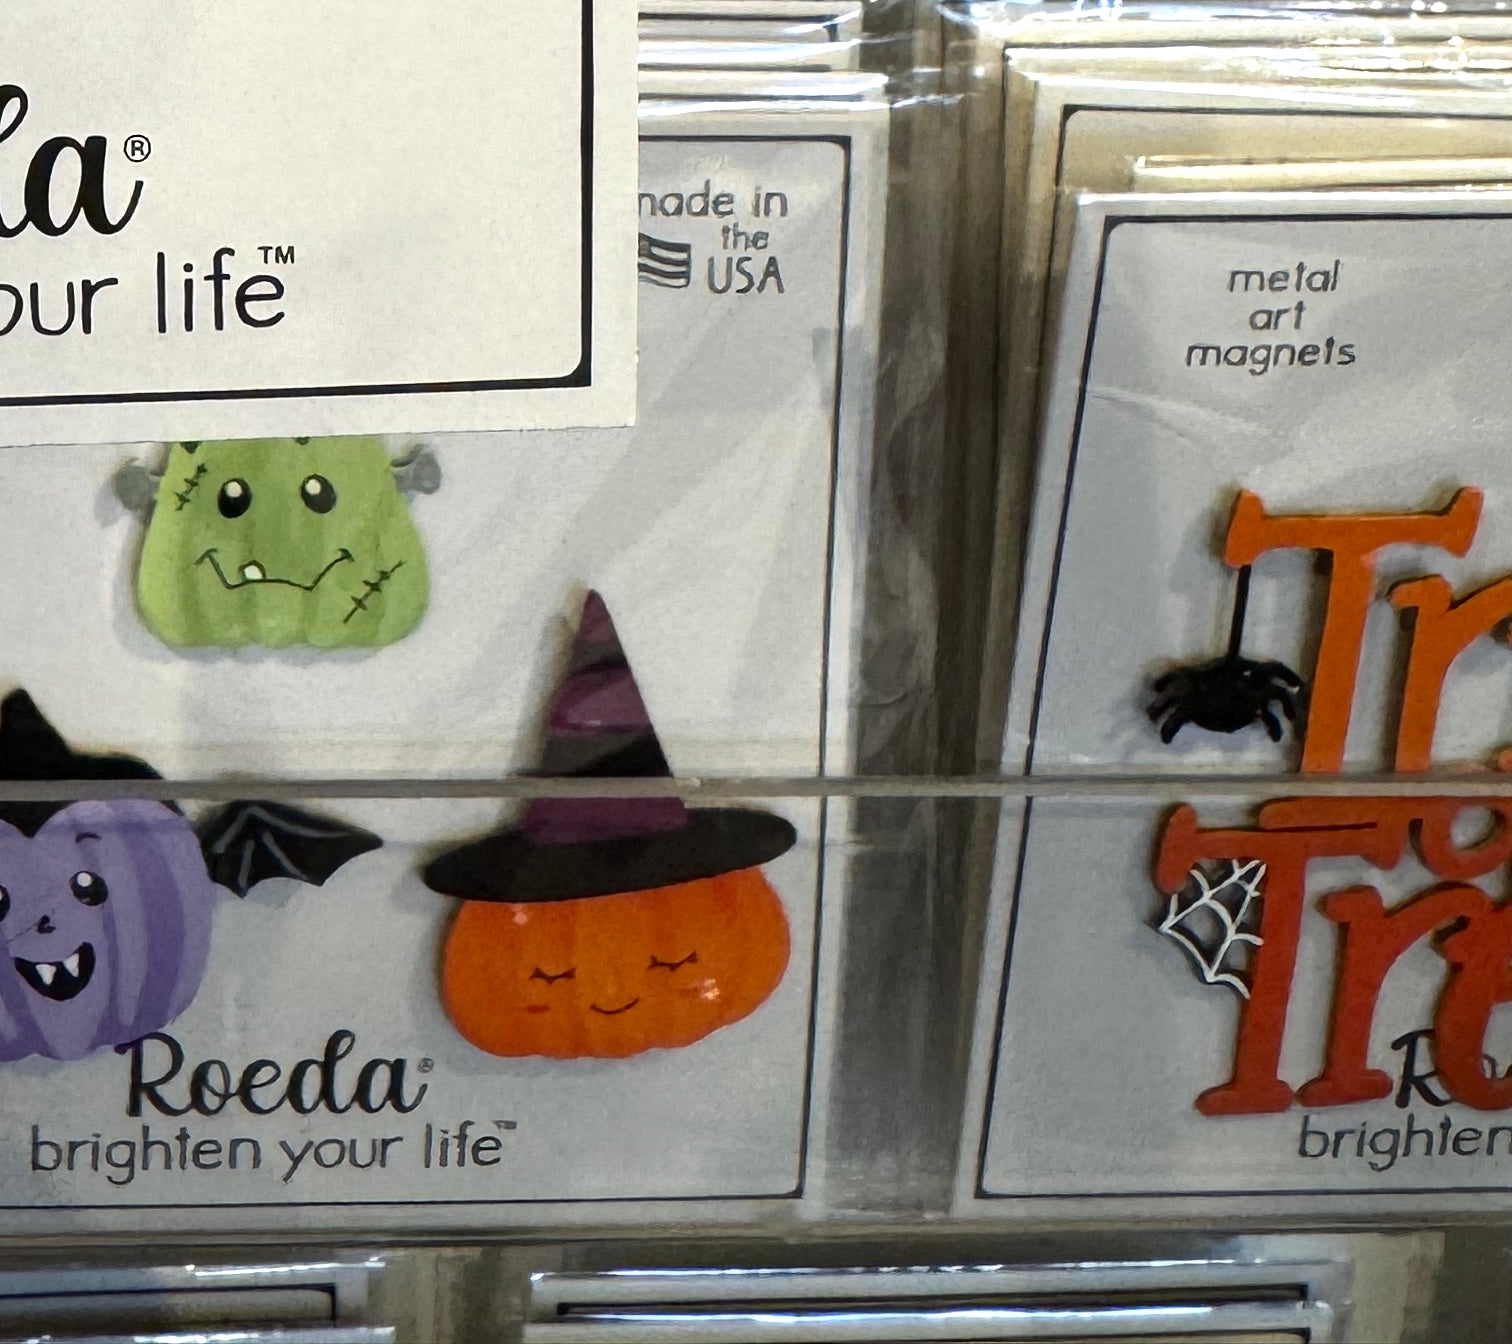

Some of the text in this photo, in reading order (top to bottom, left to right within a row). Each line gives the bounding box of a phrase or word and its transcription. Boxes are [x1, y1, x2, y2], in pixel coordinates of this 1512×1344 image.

[751, 186, 789, 218] in
[721, 222, 770, 251] the
[707, 256, 785, 295] USA
[1227, 259, 1341, 293] metal
[1249, 301, 1307, 331] art
[1186, 336, 1356, 376] magnets
[30, 1124, 262, 1185] brighten
[278, 1136, 403, 1184] your
